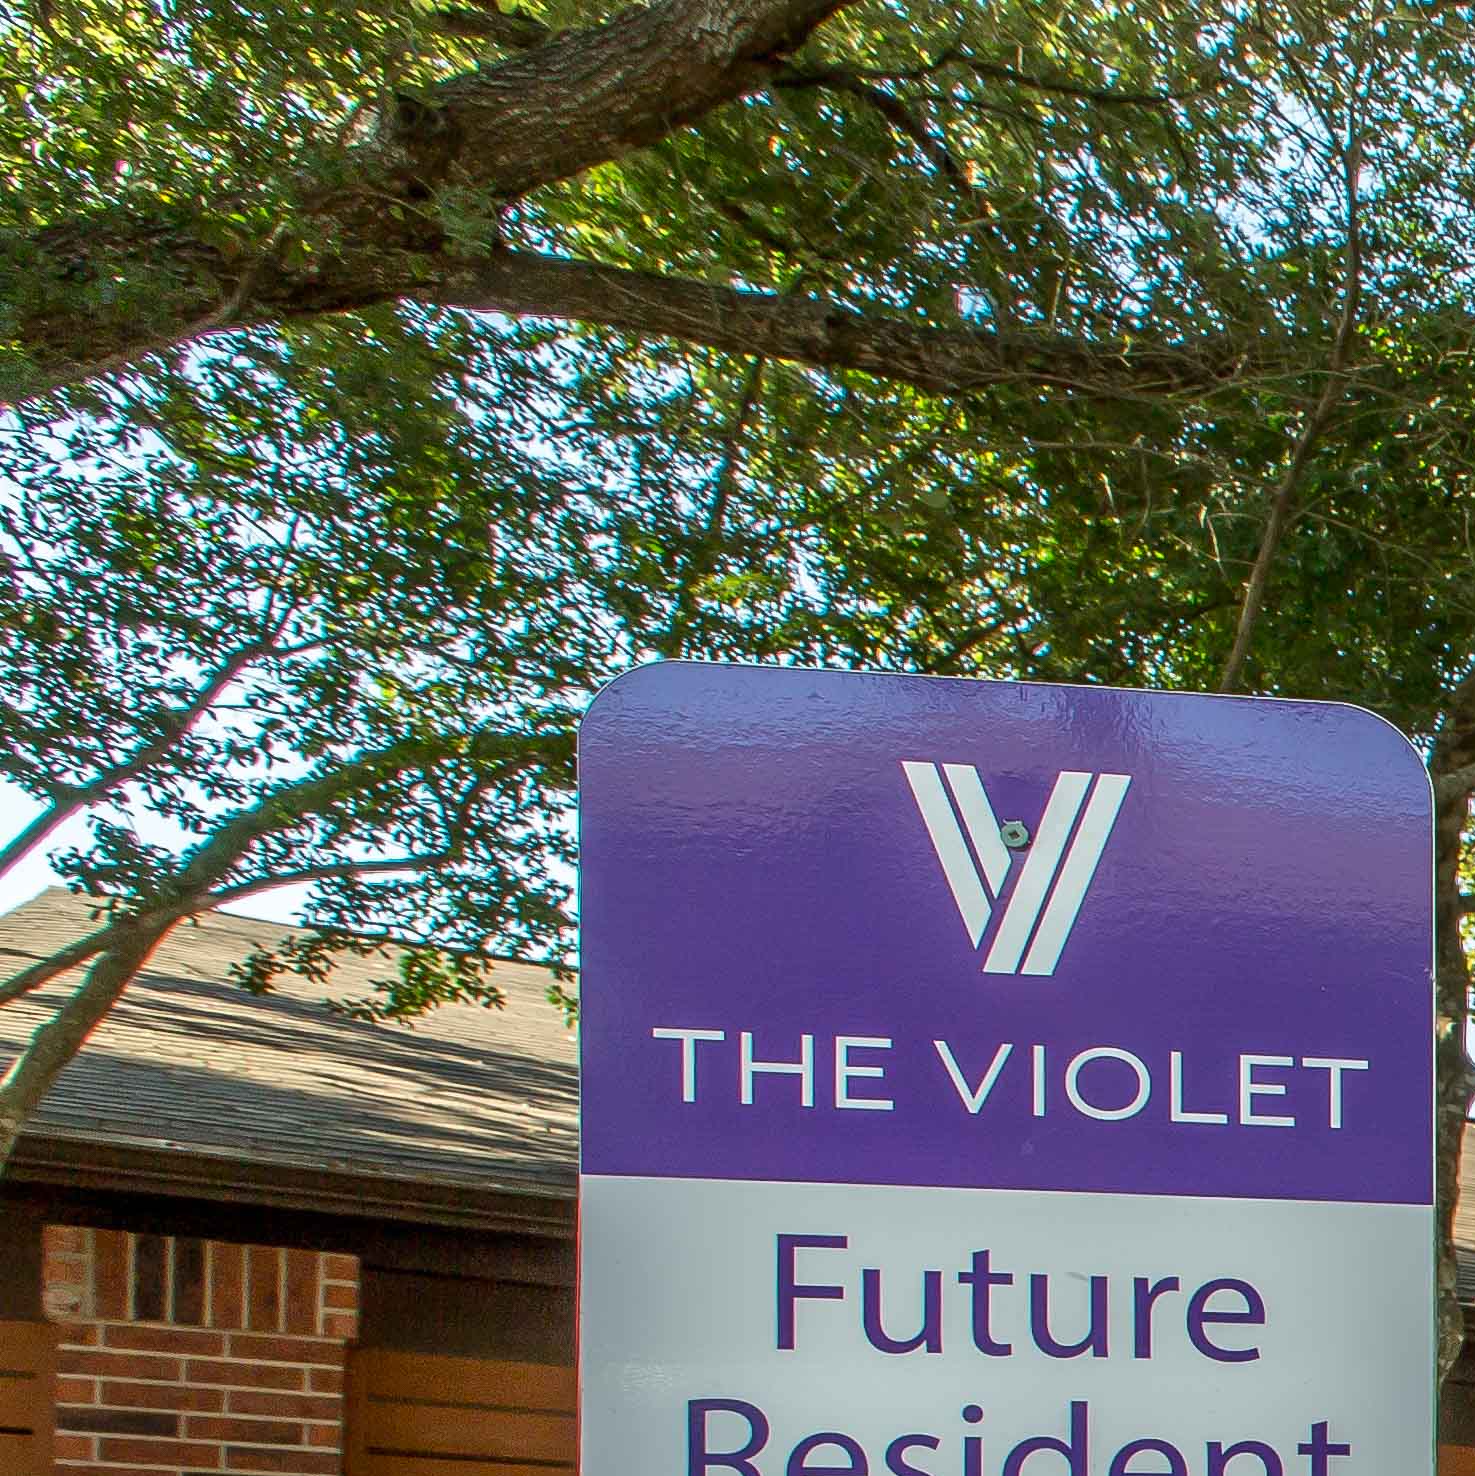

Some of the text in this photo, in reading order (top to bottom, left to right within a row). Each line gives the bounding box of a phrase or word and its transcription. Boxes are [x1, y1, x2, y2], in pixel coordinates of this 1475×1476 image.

[651, 1027, 1371, 1130] THE VIOLET
[775, 1232, 1268, 1364] Future
